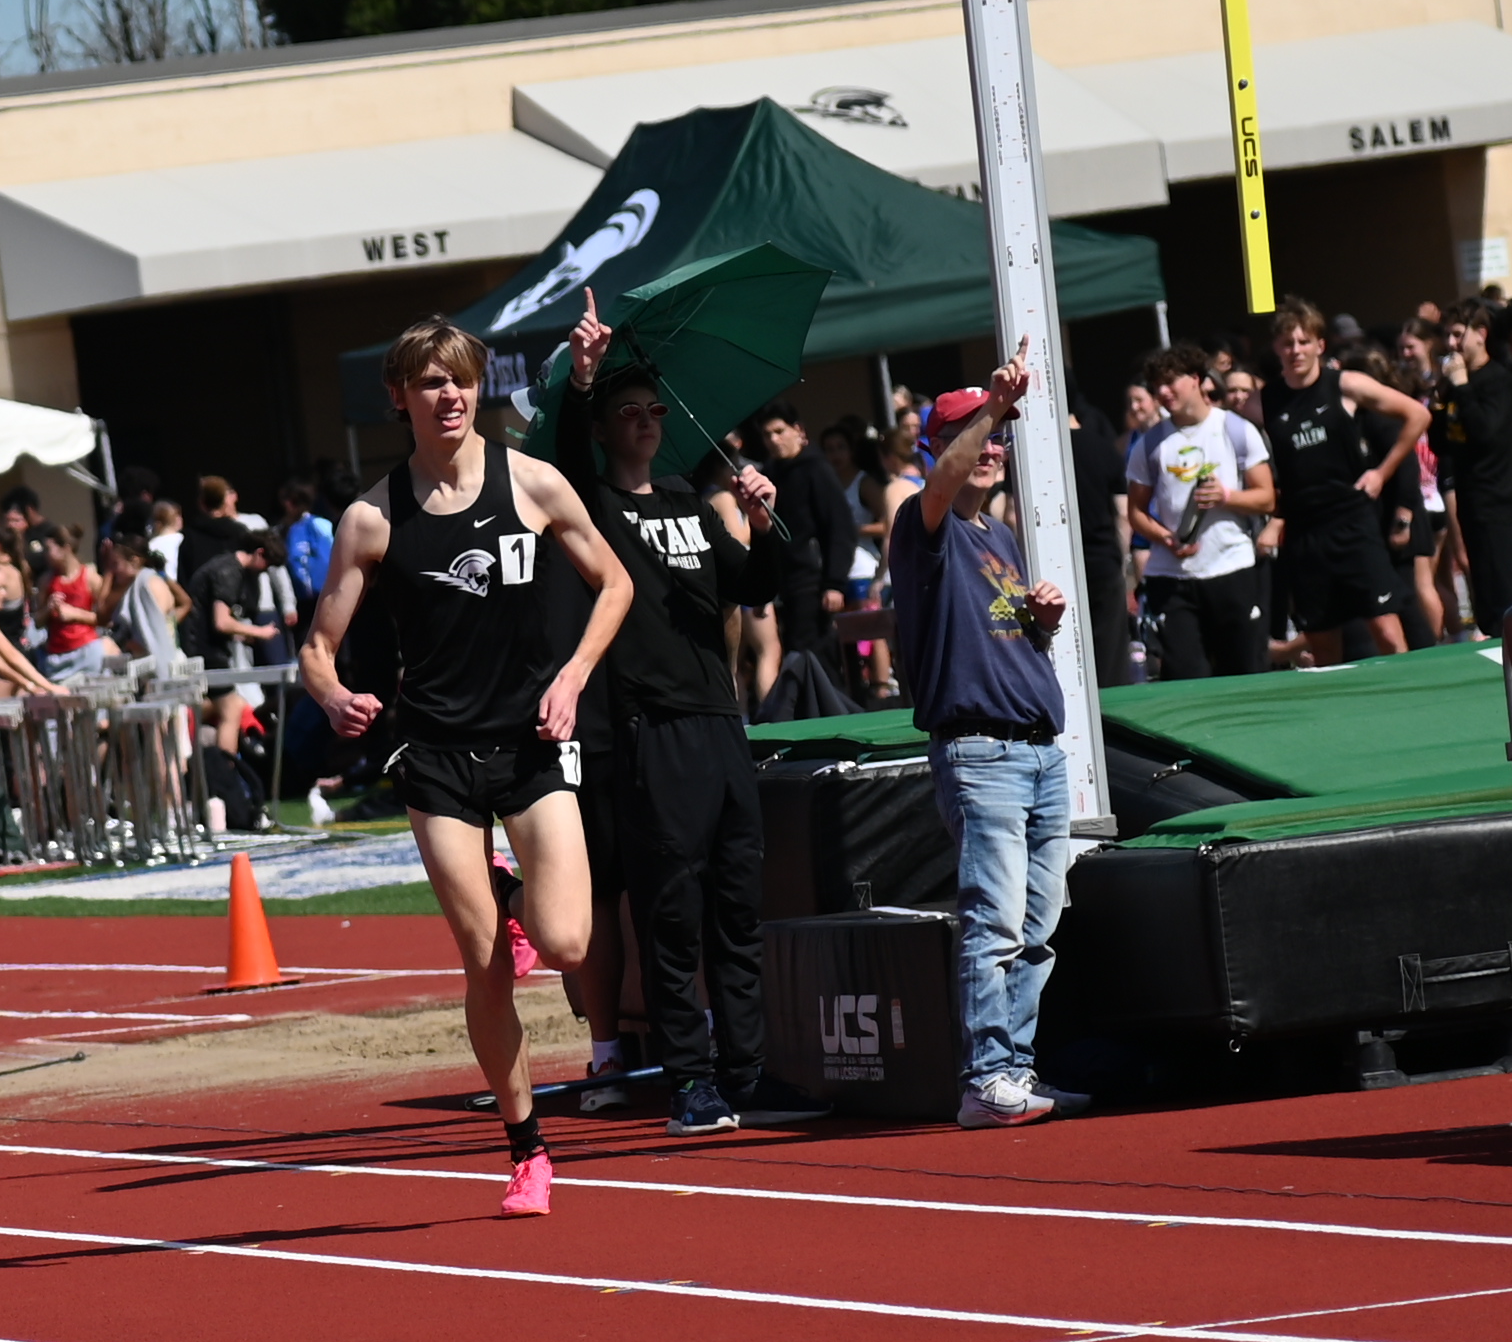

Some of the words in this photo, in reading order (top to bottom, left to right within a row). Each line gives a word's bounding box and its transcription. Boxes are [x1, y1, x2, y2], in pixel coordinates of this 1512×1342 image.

[1241, 117, 1258, 178] UCS
[1349, 116, 1451, 150] SALEM
[362, 231, 449, 261] WEST
[819, 995, 879, 1054] UCS
